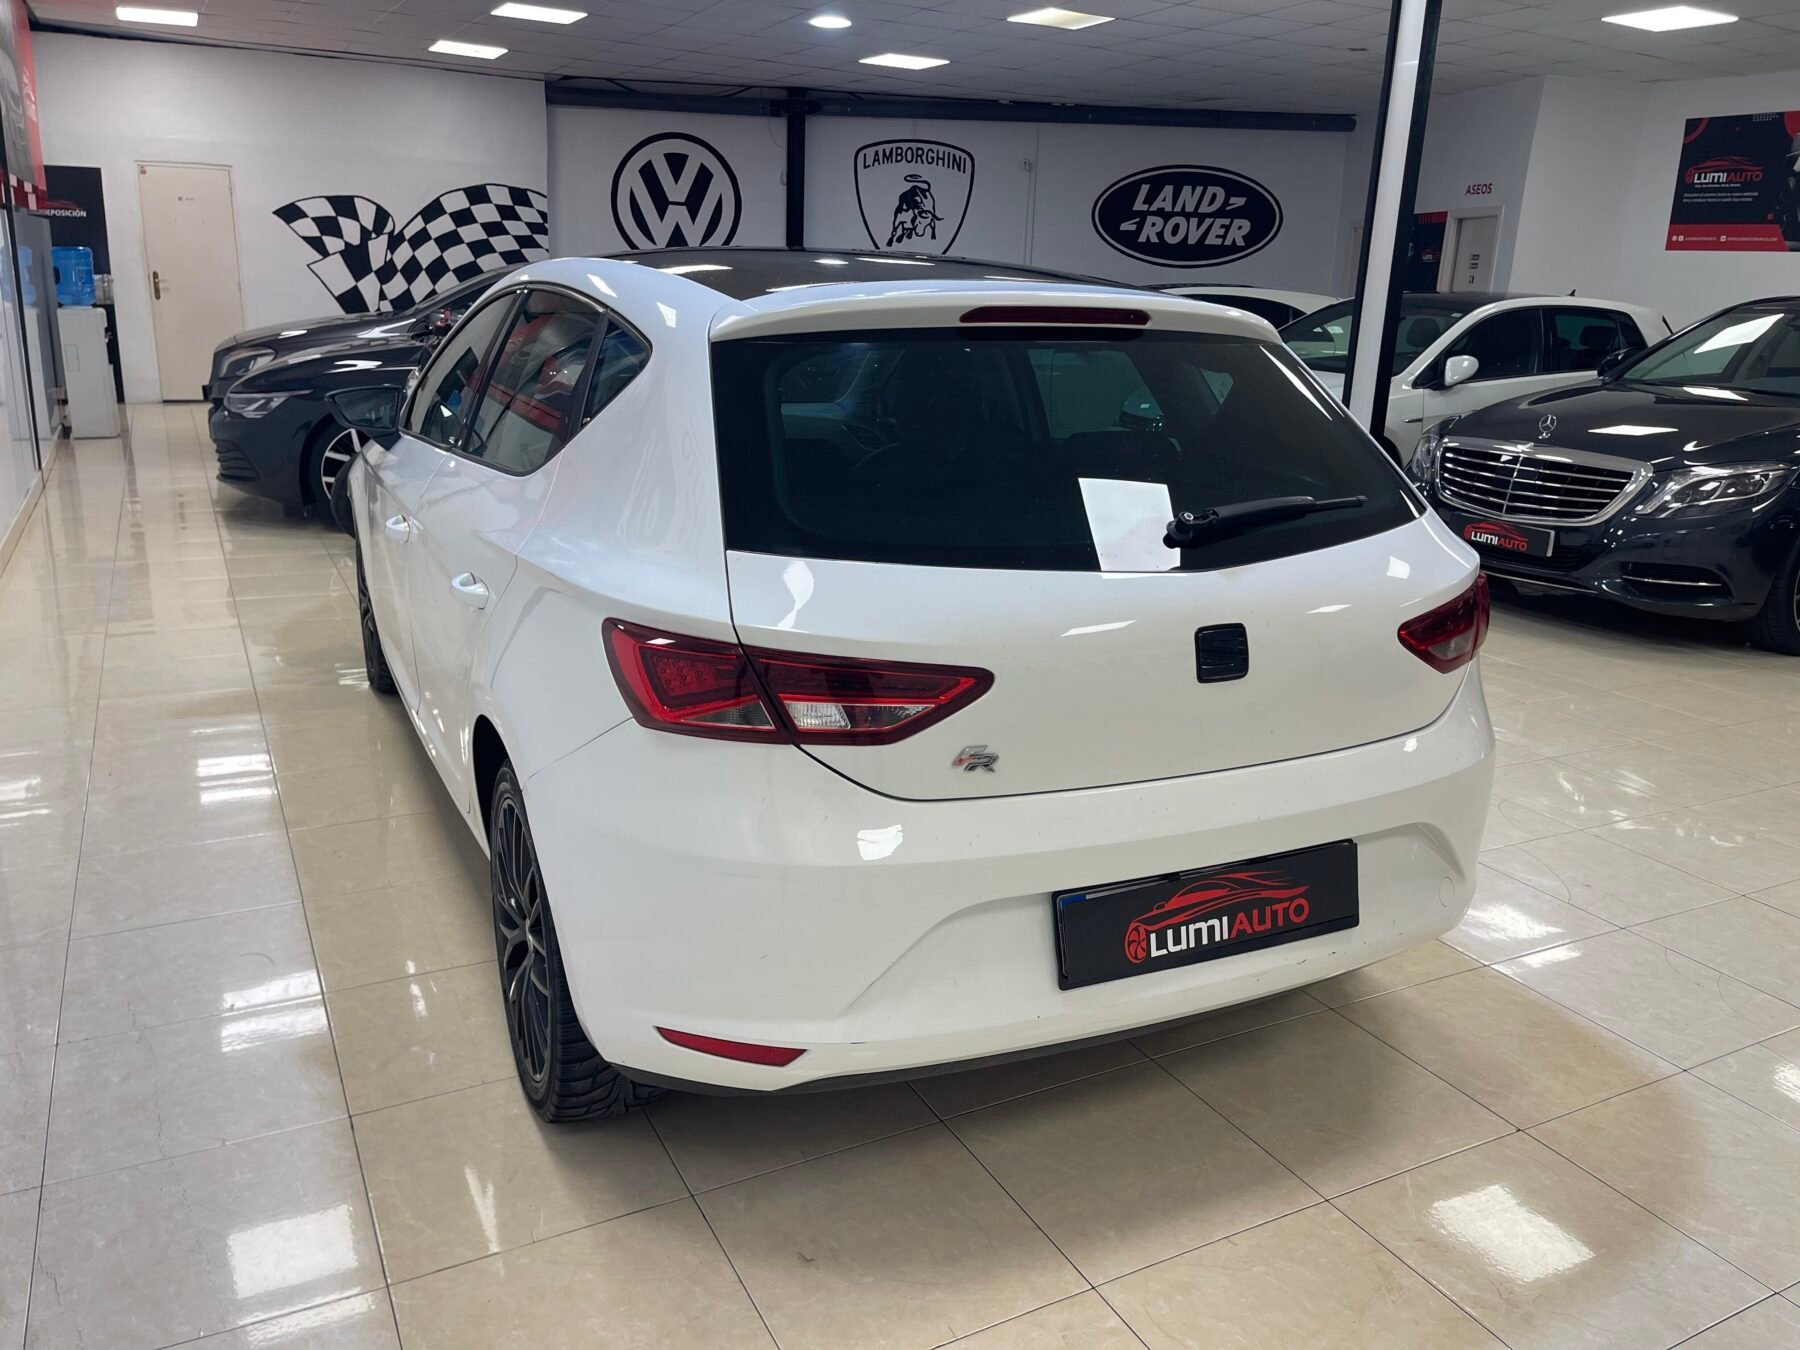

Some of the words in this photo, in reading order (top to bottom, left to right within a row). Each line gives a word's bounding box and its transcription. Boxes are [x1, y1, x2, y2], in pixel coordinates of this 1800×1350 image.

[862, 146, 968, 174] LAMBORGHINI
[1131, 184, 1226, 214] LAND
[1465, 183, 1493, 195] ASEOS
[1137, 215, 1251, 246] ROVER
[1149, 897, 1310, 958] LUMIAUTO
